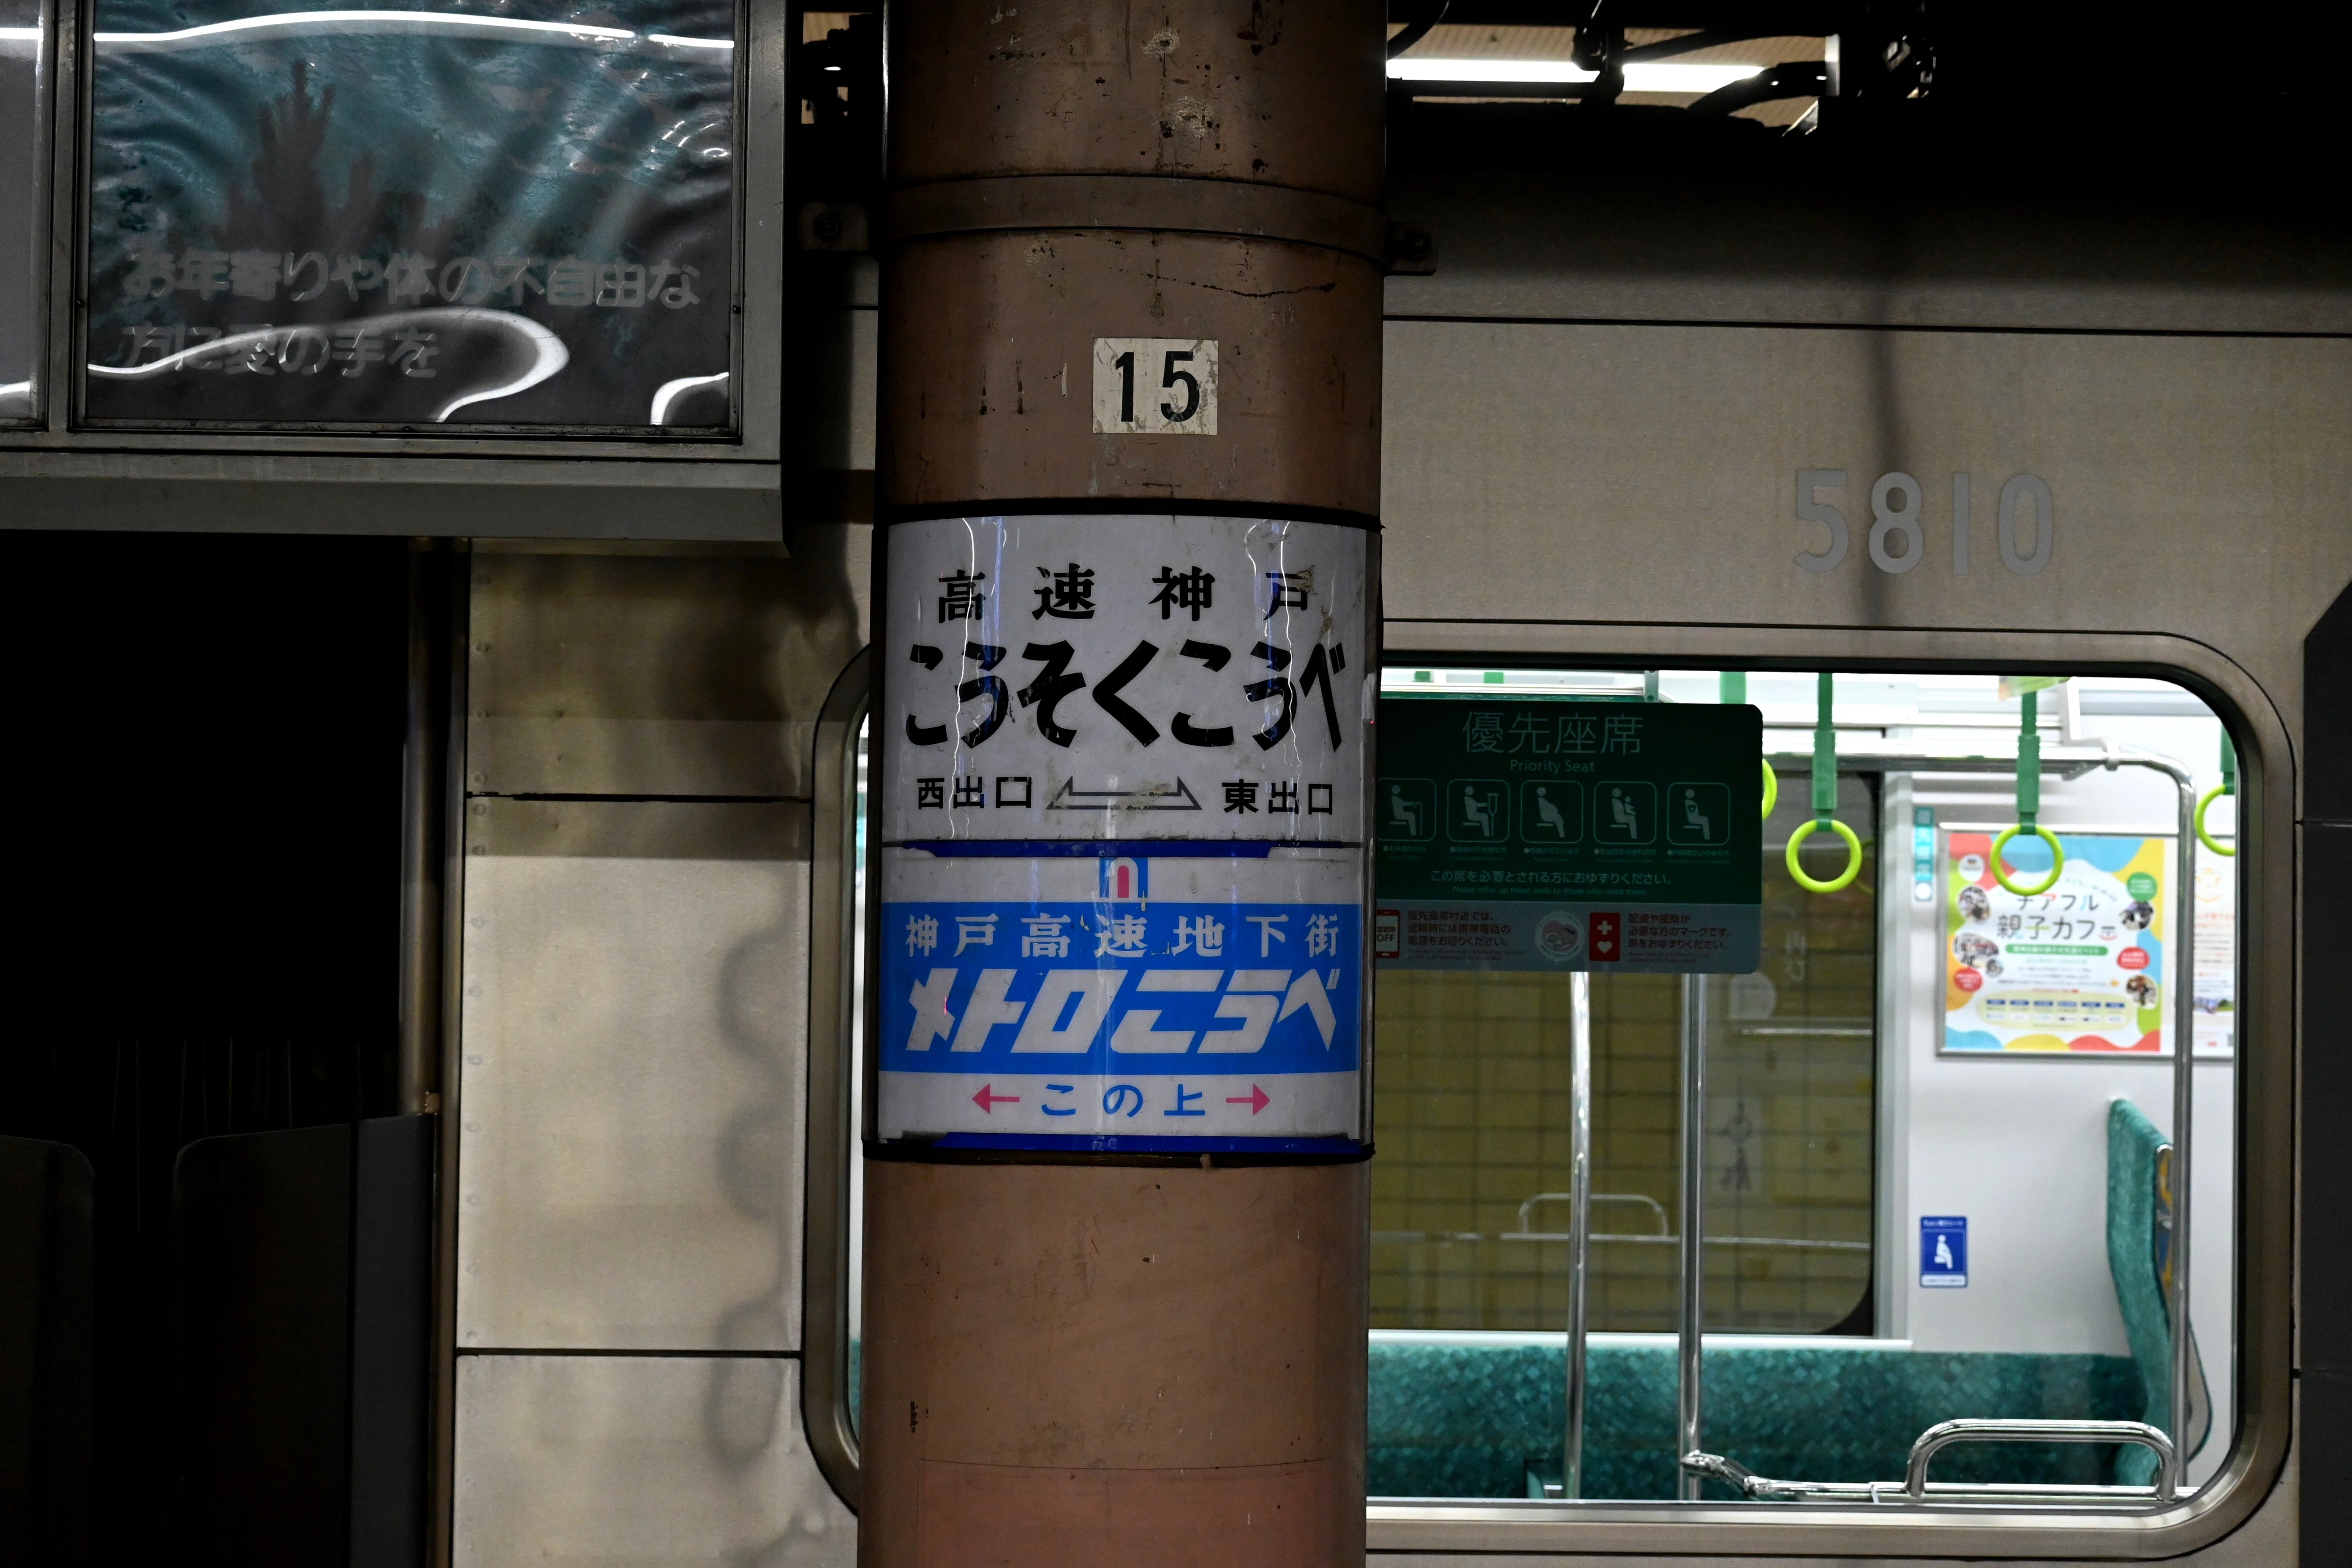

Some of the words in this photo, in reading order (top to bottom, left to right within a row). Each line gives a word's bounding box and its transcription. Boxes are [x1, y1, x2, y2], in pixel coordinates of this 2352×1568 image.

[121, 252, 700, 309] お年寄りや体の不自由な
[121, 325, 438, 378] 方に愛の手を
[1116, 351, 1200, 422] 15
[1794, 470, 2053, 576] 5810
[938, 563, 1313, 624] 高速神戸
[906, 640, 1346, 753] こうそくこうべ
[1462, 711, 1643, 756] 優先座席
[1510, 760, 1560, 775] Priority
[1565, 760, 1595, 772] Seat
[917, 776, 1032, 811] 西出口
[1222, 779, 1333, 816] 東出口
[1431, 870, 1671, 885] この席を必要とされる方におゆずりください。
[2017, 893, 2099, 910] チアフル
[905, 912, 1338, 958] 神戸高速地下街
[906, 968, 1340, 1053] メトロこうべ
[1041, 1083, 1205, 1117] この上
